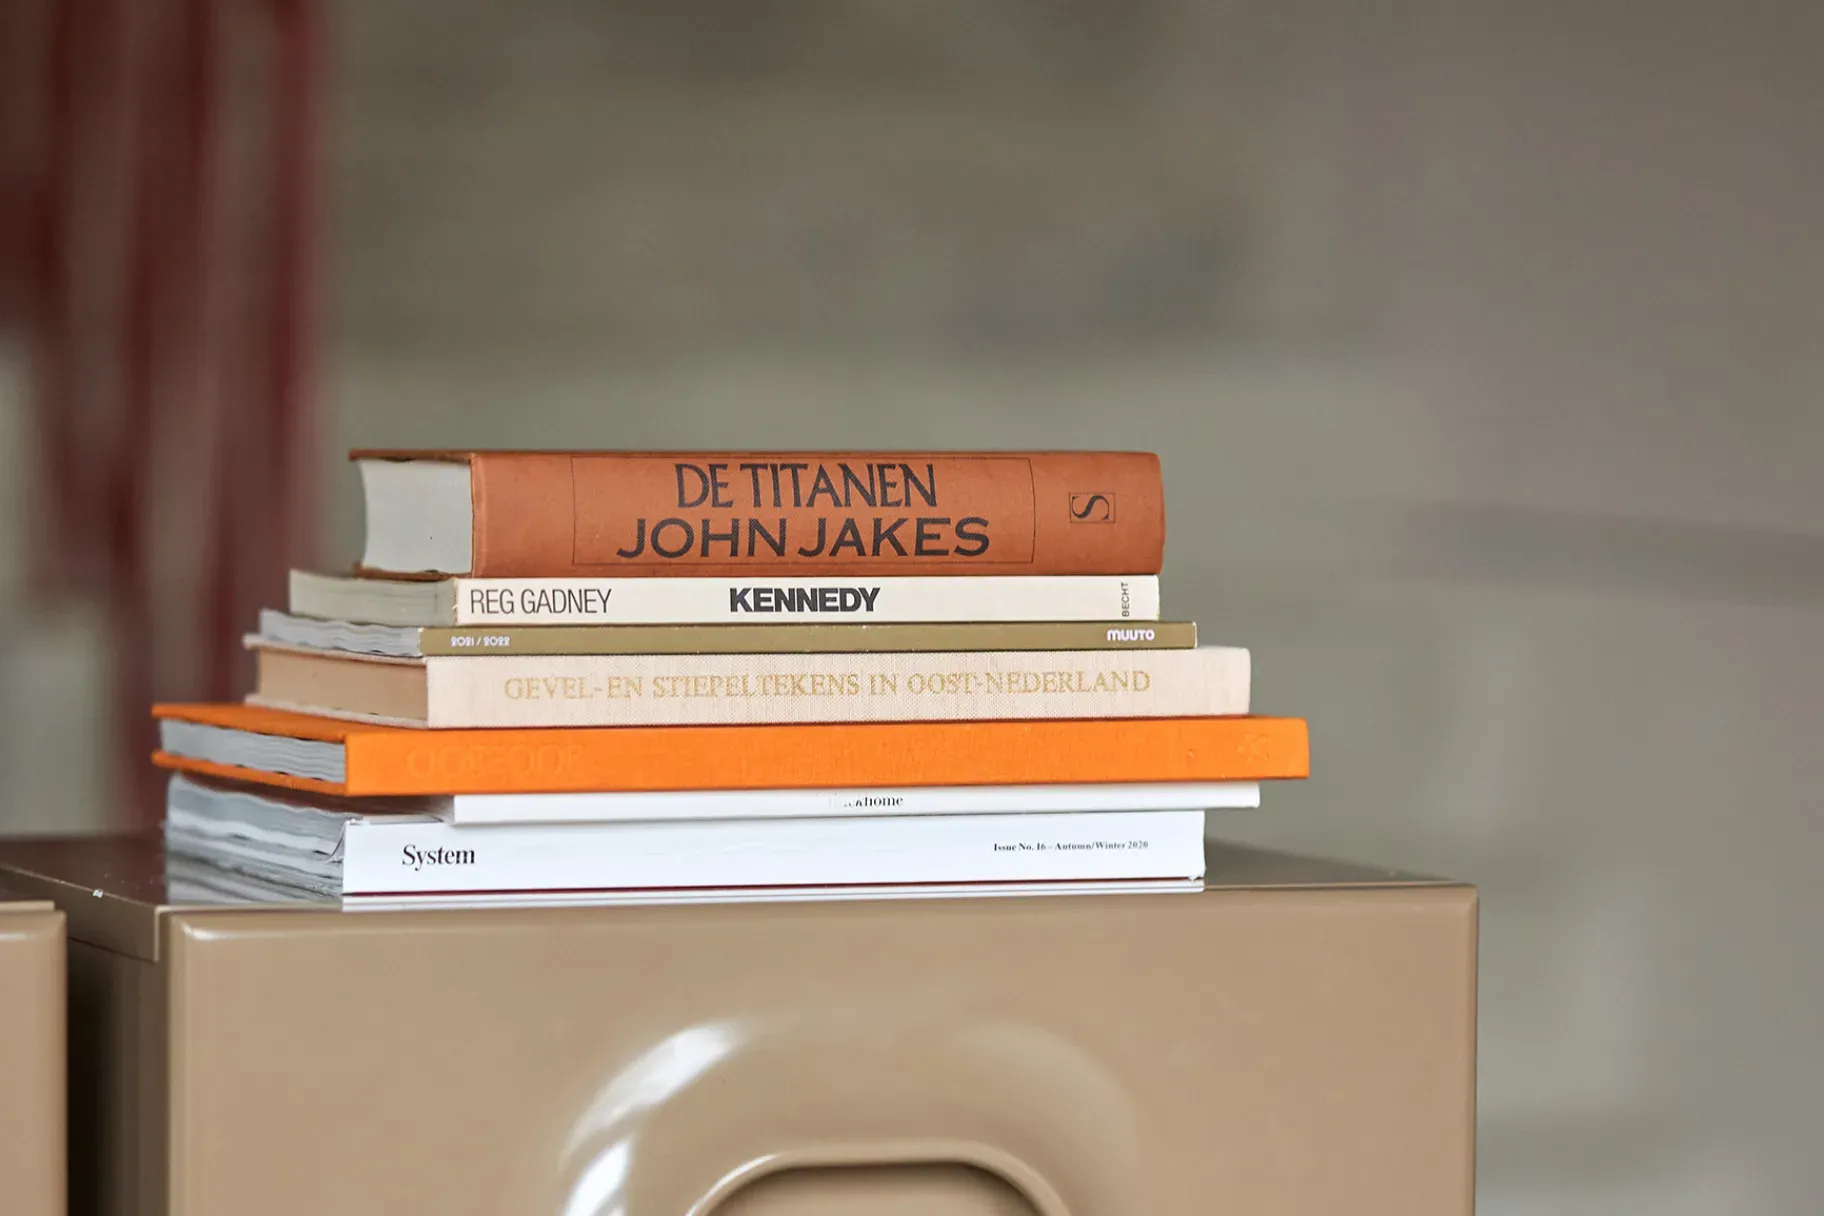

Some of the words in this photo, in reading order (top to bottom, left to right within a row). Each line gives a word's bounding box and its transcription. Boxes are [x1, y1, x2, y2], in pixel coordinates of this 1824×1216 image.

[675, 463, 734, 508] DE
[739, 463, 938, 508] TITANEN
[616, 517, 788, 558] JOHN
[797, 516, 990, 558] JAKES
[470, 588, 515, 614] REG
[520, 588, 613, 614] GADNEY
[729, 587, 881, 613] KENNEDY
[1121, 581, 1130, 618] BECHT
[451, 635, 474, 647] 2021
[483, 635, 511, 647] 2022
[606, 675, 644, 699] EN
[868, 672, 898, 696] IN
[401, 843, 476, 872] System
[993, 842, 1017, 852] Issue
[1018, 842, 1034, 852] No.
[1054, 840, 1127, 851] Autumn/Winter
[1128, 840, 1149, 850] 2020
